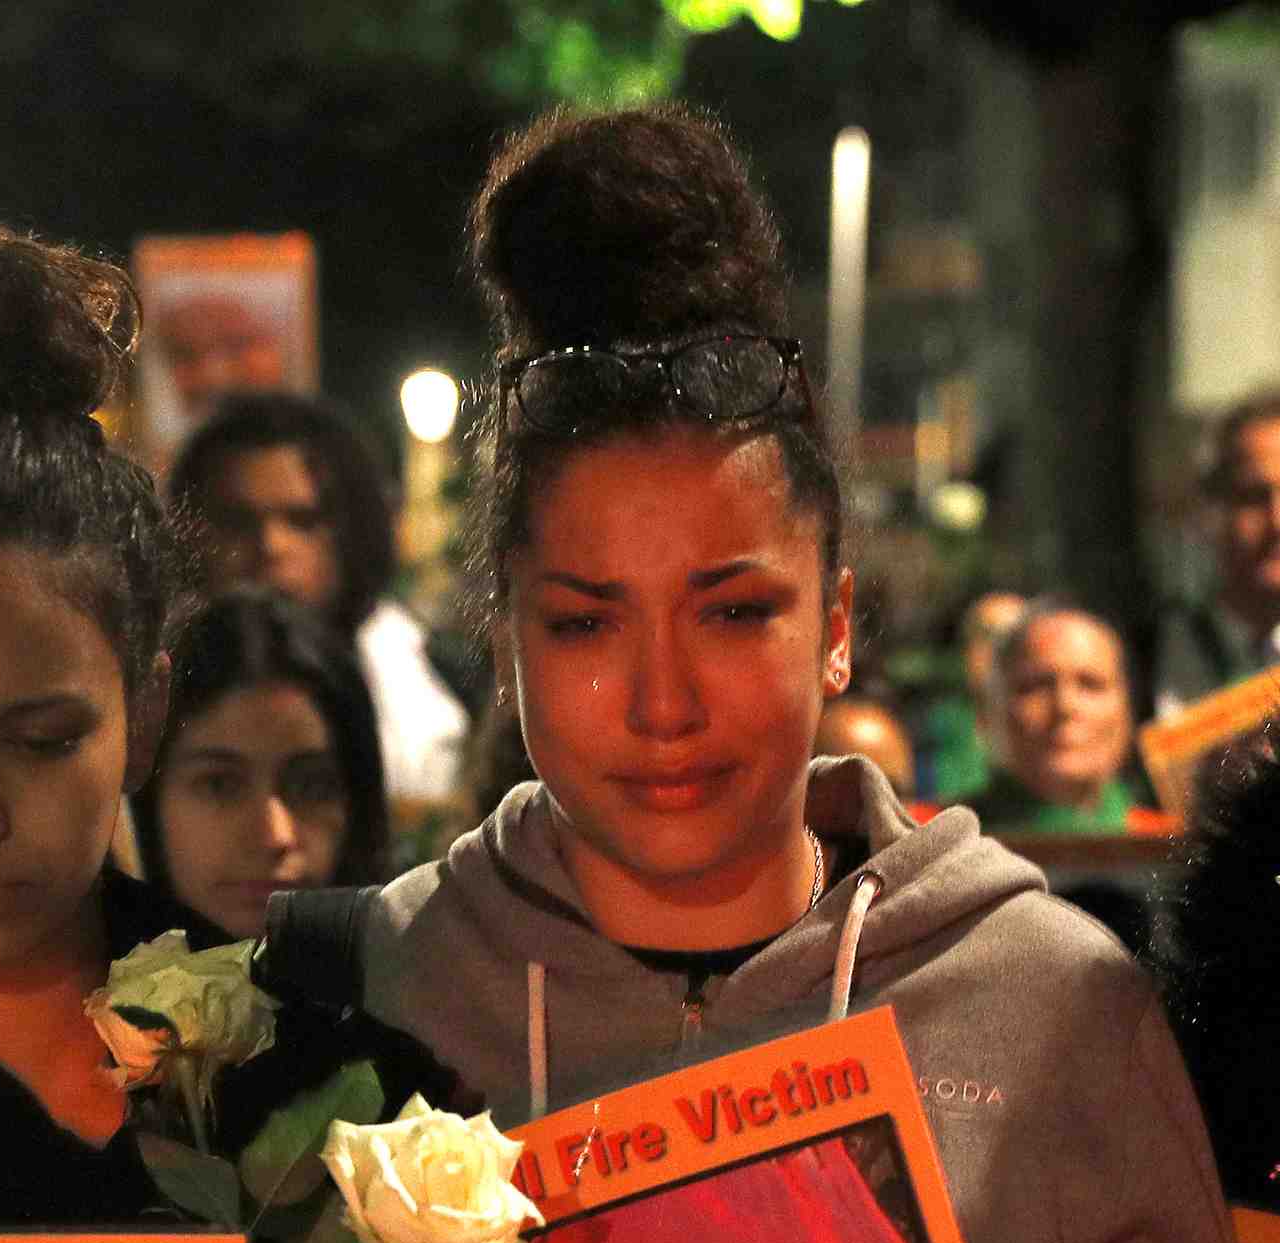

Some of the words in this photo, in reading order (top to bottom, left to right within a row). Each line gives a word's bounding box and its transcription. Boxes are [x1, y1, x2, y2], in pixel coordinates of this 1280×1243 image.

[555, 1122, 669, 1187] Fire
[672, 1057, 869, 1144] Victim
[917, 1075, 1007, 1105] SODA
